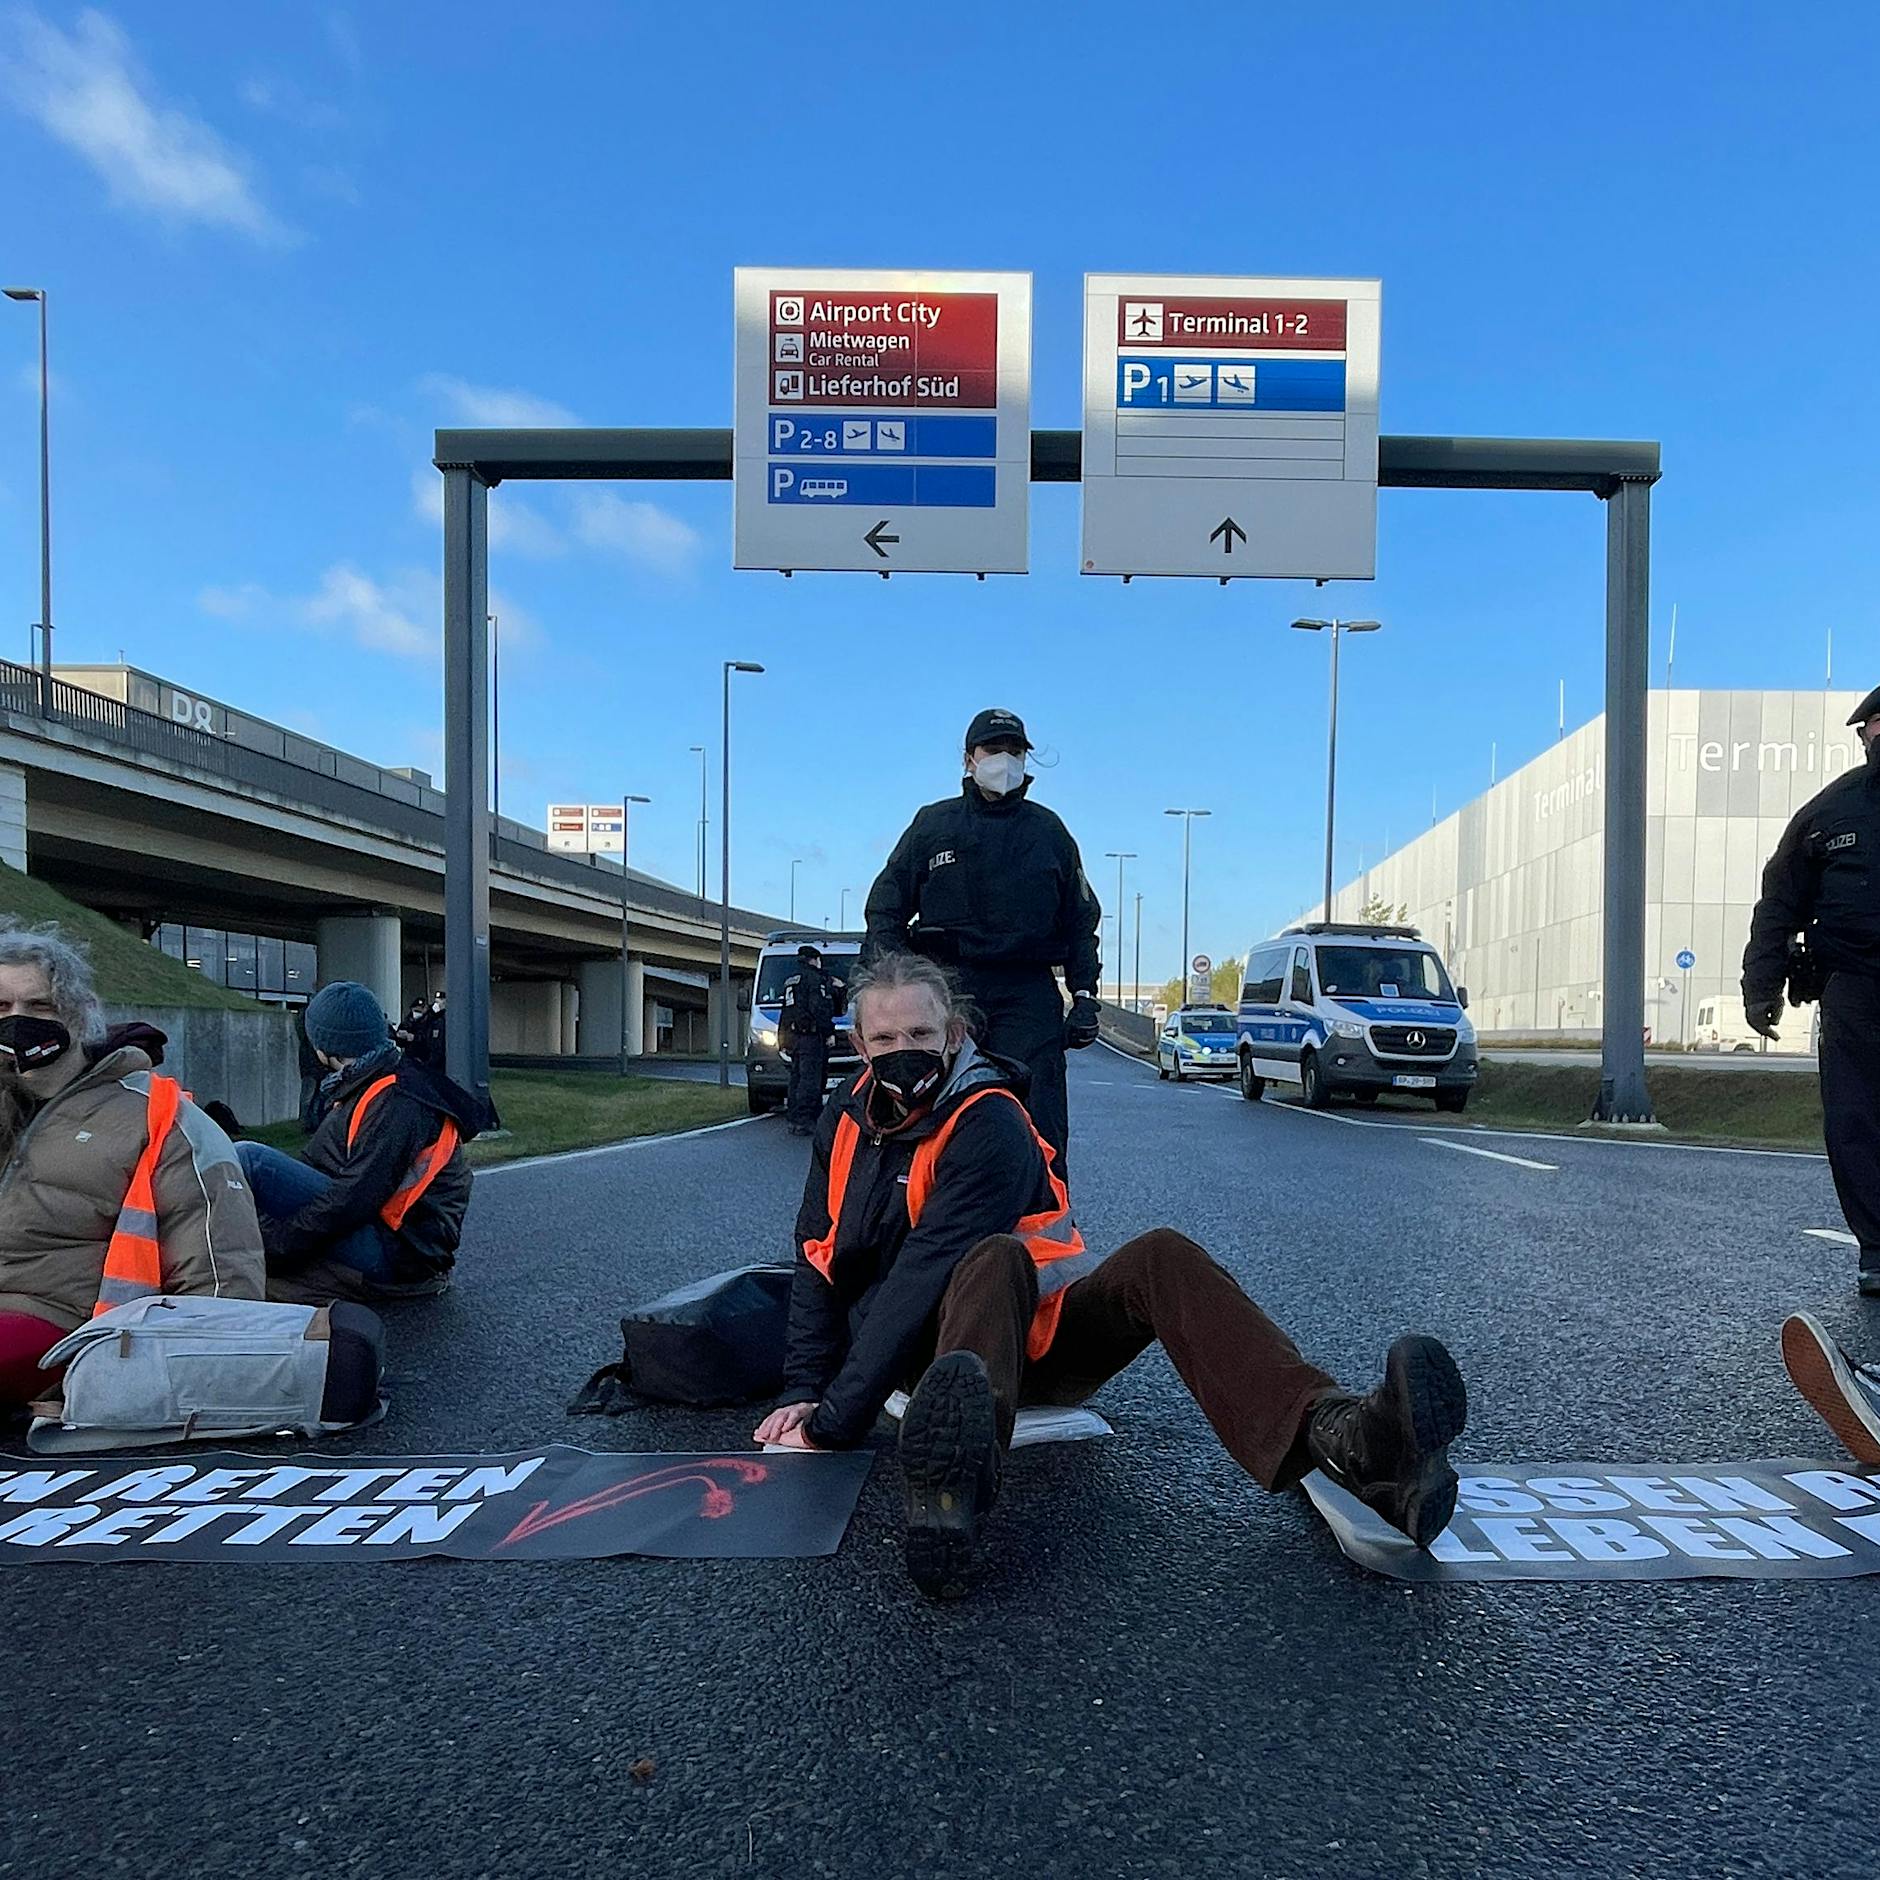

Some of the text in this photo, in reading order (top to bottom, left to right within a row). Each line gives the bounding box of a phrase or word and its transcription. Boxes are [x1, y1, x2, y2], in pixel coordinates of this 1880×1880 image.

[810, 301, 941, 328] Airport City
[1169, 312, 1309, 335] Terminal 1-2
[809, 331, 910, 353] Mietwagen
[808, 353, 879, 367] Car Rental
[808, 374, 959, 397] Lieferhof Süd
[1124, 363, 1168, 402] P 1
[774, 419, 837, 449] P 2-8
[774, 468, 795, 498] P
[1670, 732, 1867, 774] Termin
[1534, 752, 1601, 823] Terminal
[0, 1456, 547, 1503] N RETTEN
[1453, 1475, 1798, 1513] SSEN
[0, 1501, 484, 1547] RETTEN
